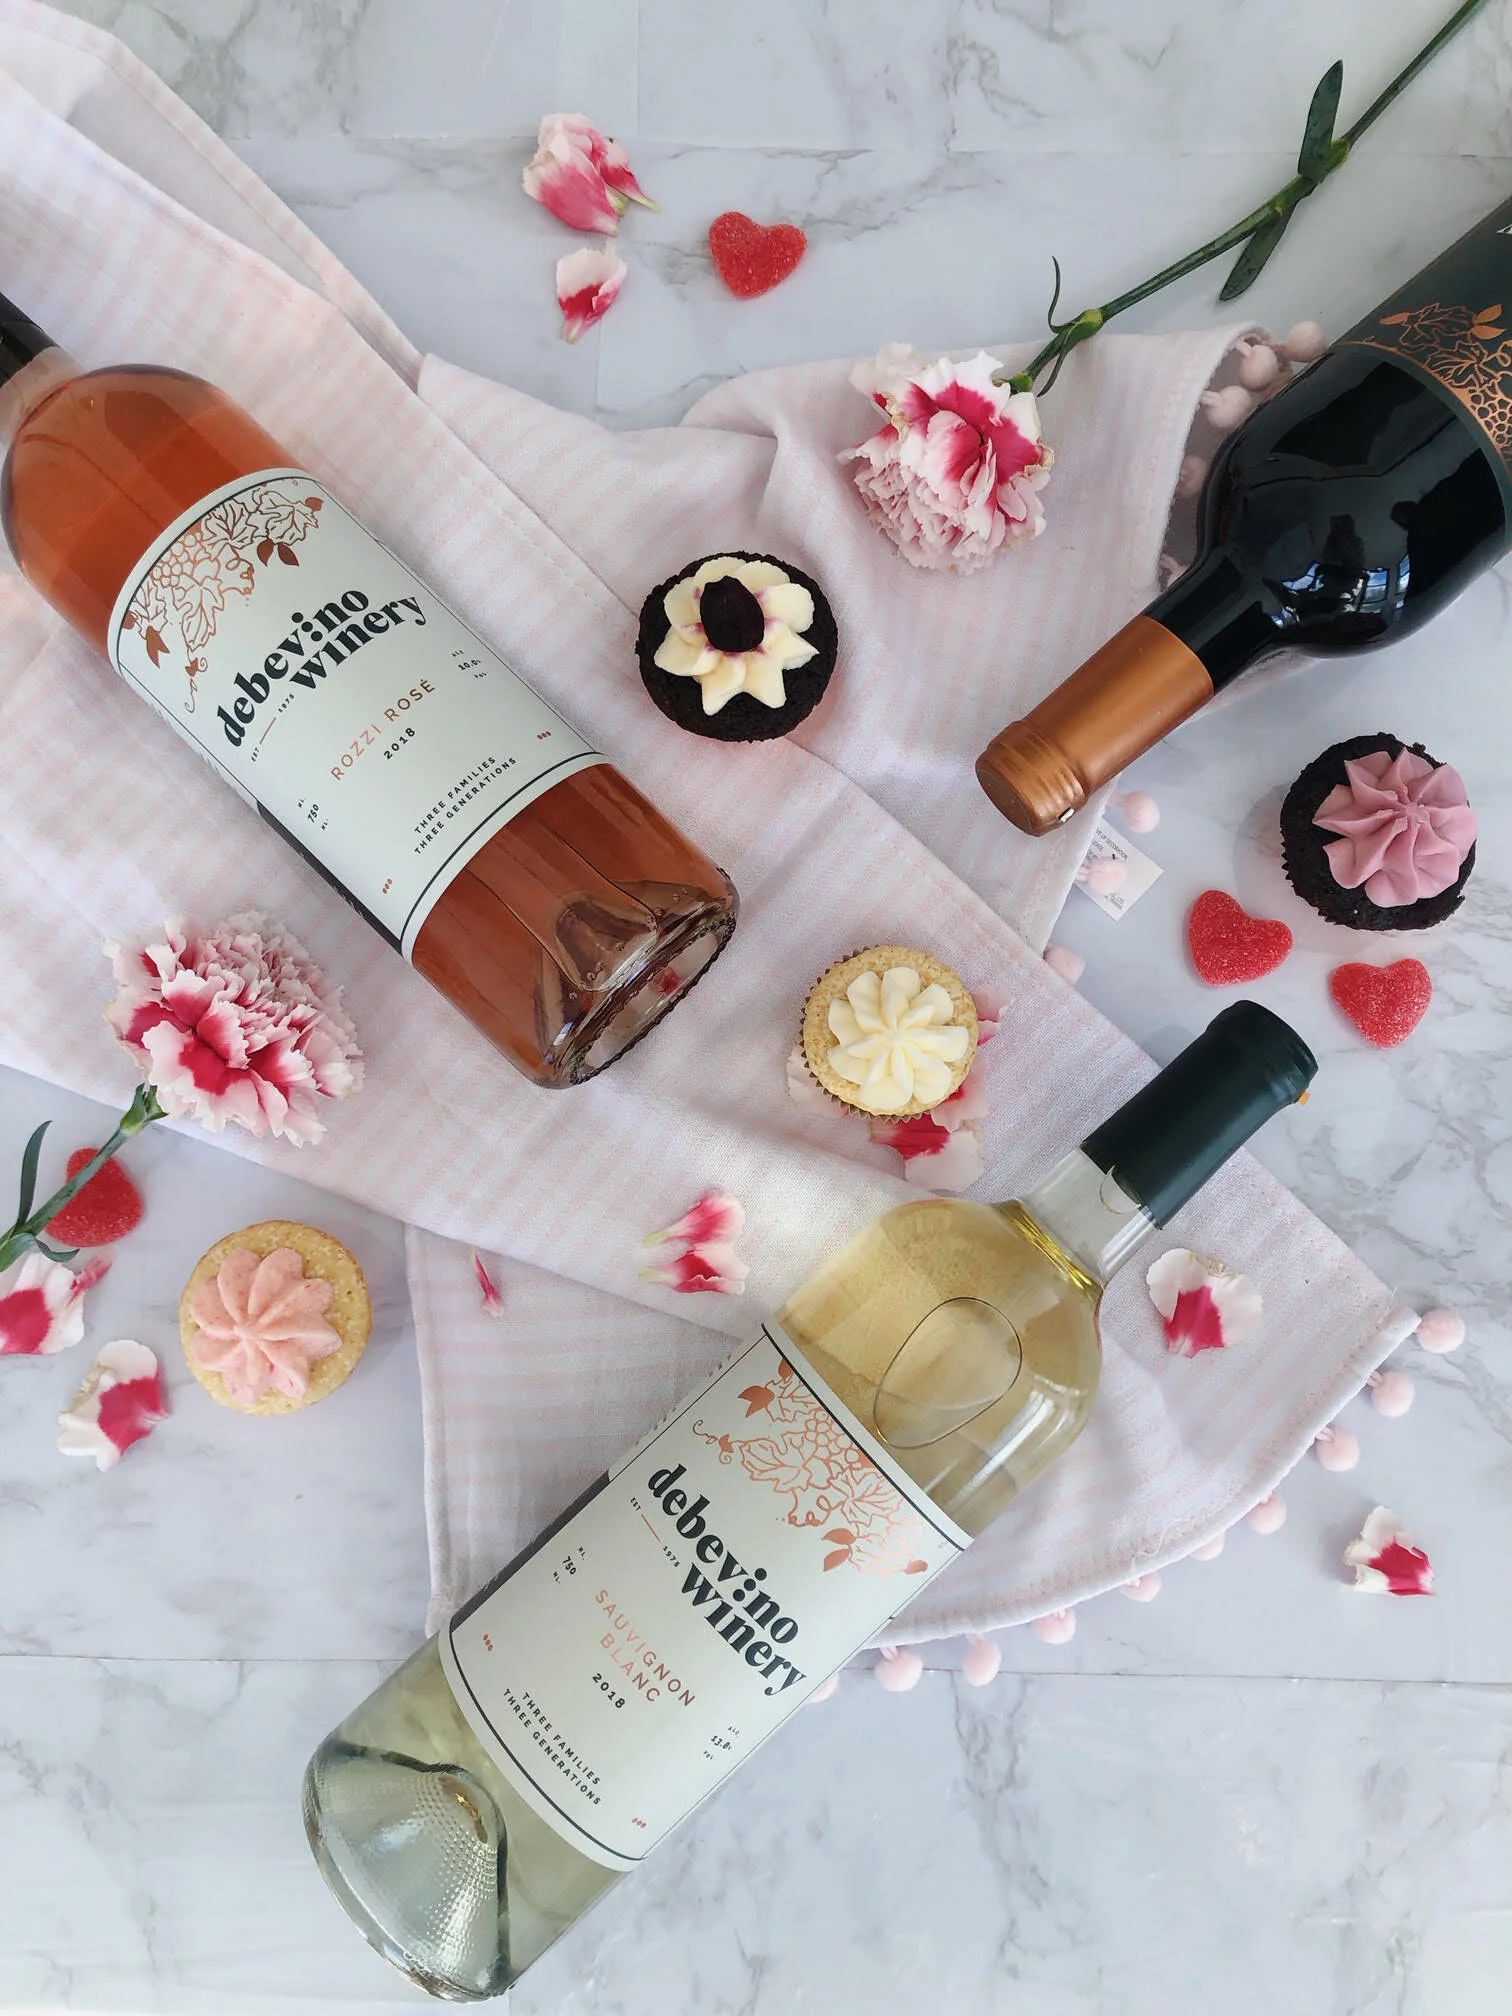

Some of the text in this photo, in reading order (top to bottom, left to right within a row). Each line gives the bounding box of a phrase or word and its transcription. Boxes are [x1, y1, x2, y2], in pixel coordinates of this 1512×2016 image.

[289, 597, 426, 689] winery
[330, 724, 382, 781] ROZZI
[383, 727, 416, 760] 2018
[307, 804, 319, 823] 750
[414, 756, 496, 834] THREE FAMILIES
[414, 757, 517, 855] THREE GENERATIONS
[630, 1497, 641, 1512] EST
[562, 1556, 577, 1576] 750
[595, 1589, 696, 1707] SAUVIGNON
[681, 1562, 807, 1697] winery
[592, 1672, 626, 1710] 2018
[600, 1632, 660, 1702] BLANC
[503, 1688, 601, 1805] THREE GENERATIONS
[521, 1691, 600, 1785] THREE FAMILIES
